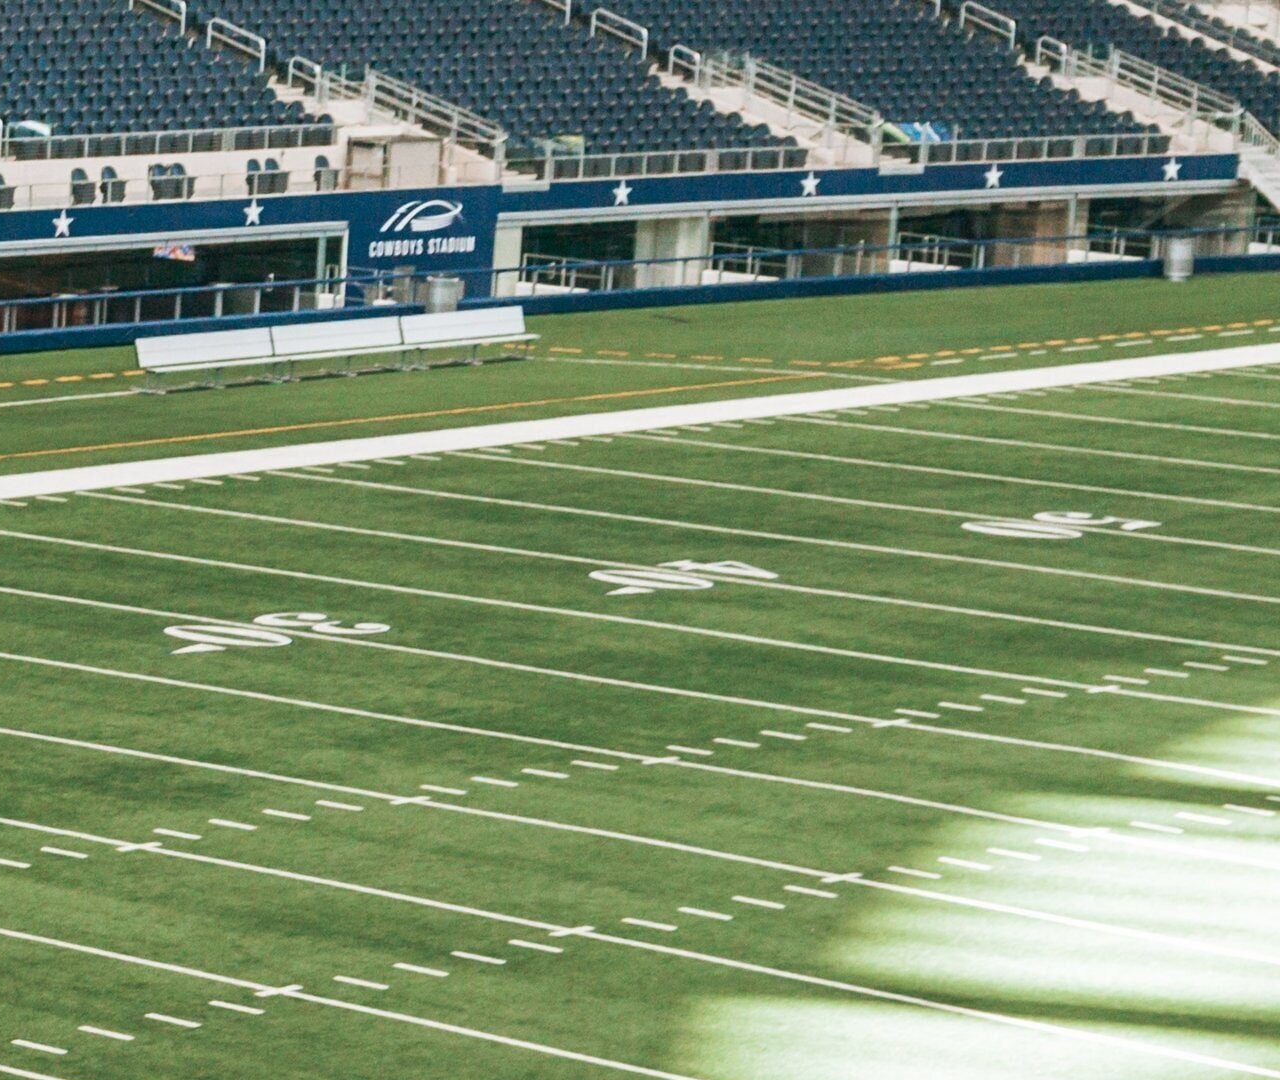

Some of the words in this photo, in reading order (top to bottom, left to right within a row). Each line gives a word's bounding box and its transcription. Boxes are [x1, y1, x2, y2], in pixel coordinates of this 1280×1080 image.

[368, 238, 424, 258] COWBOYS
[426, 235, 476, 255] STADIUM
[960, 511, 1163, 540] 50
[589, 559, 780, 590] 40
[163, 612, 391, 647] 30
